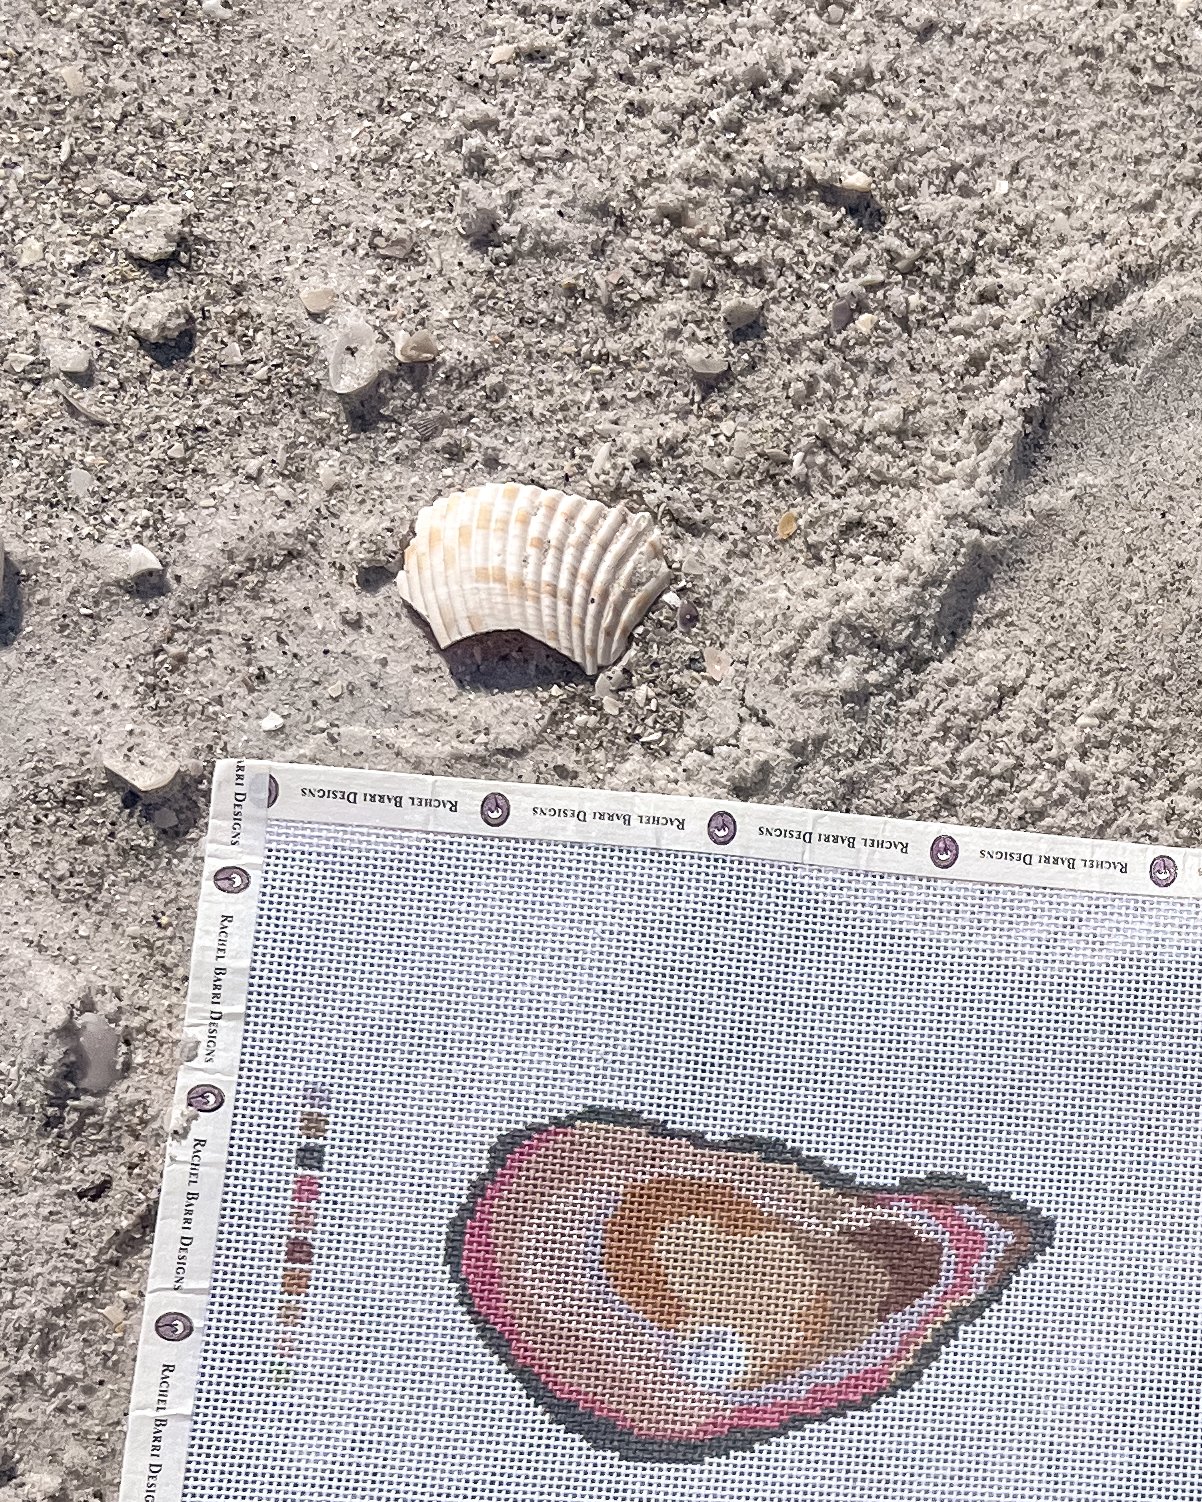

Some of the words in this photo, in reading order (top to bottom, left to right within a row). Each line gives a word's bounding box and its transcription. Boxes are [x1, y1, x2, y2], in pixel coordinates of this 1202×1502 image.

[300, 787, 358, 805] DESIGNS
[363, 792, 403, 809] BARRI
[408, 796, 459, 813] RACHEL
[230, 791, 247, 846] DESIGNS
[532, 806, 587, 823] DESIGNS
[592, 811, 632, 827] BARRI
[637, 815, 686, 831] RACHEL
[758, 826, 813, 844] DESIGNS
[817, 833, 856, 849] BARRI
[861, 837, 909, 855] RACHEL
[979, 849, 1033, 866] DESIGNS
[1038, 854, 1077, 870] BARRI
[1080, 858, 1128, 874] RACHEL
[215, 914, 234, 961] RACHEL
[210, 967, 227, 1005] BARRI
[204, 1010, 224, 1063] DESIGNS
[187, 1138, 207, 1186] RACHEL
[181, 1191, 200, 1231] BARRI
[174, 1235, 194, 1291] DESIGNS
[156, 1363, 176, 1411] RACHEL
[150, 1418, 168, 1458] BARRI
